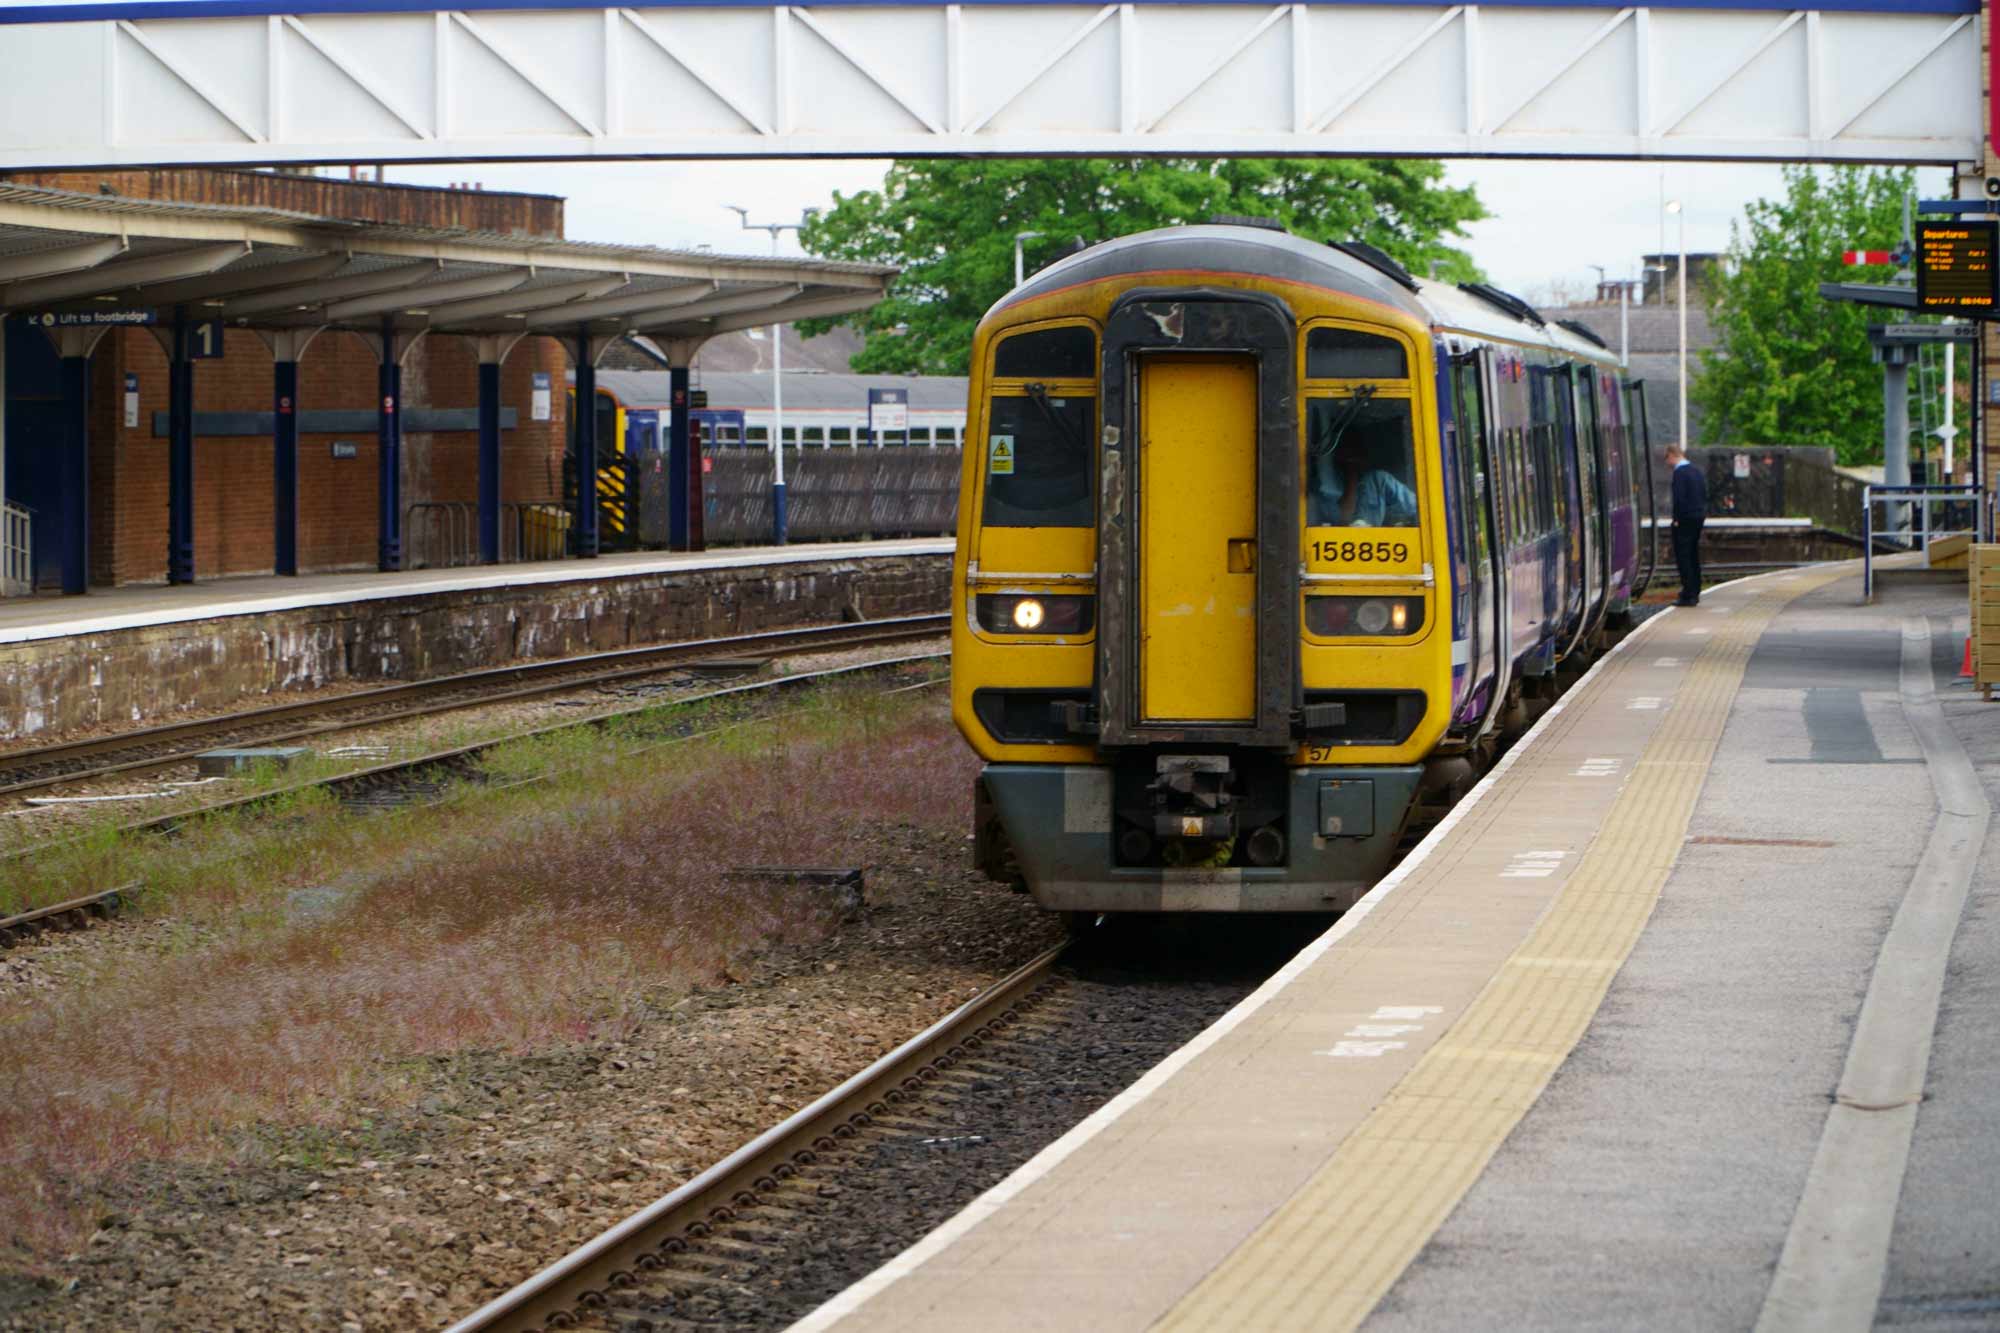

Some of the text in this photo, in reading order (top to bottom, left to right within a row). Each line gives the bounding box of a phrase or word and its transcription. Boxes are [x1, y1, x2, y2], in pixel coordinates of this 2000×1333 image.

[59, 311, 149, 324] Lift to footbridge
[197, 323, 213, 355] 1
[1312, 541, 1408, 563] 158859
[1310, 745, 1332, 761] 57
